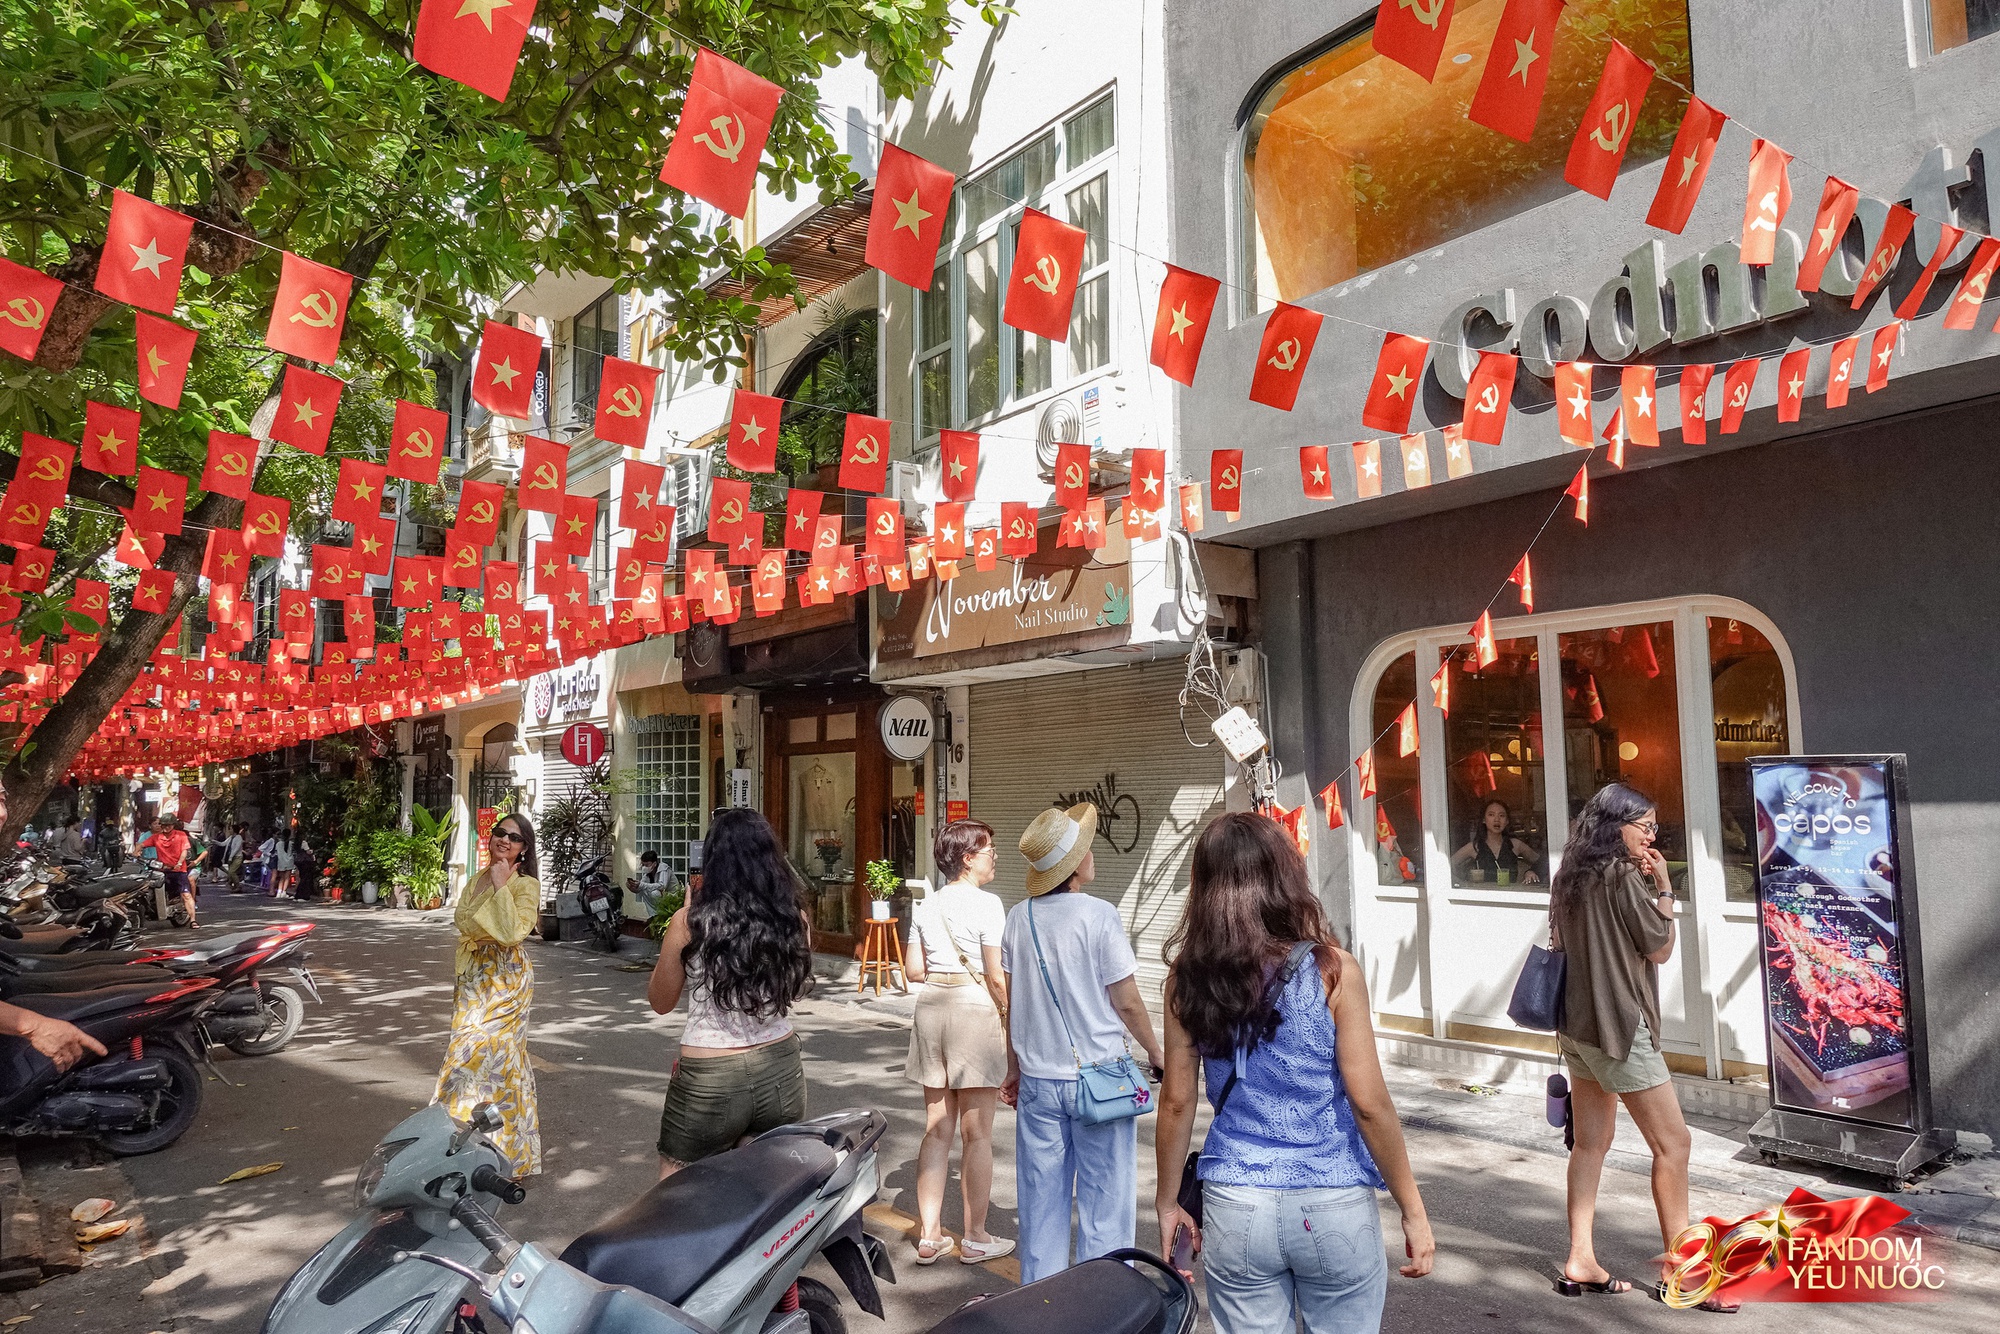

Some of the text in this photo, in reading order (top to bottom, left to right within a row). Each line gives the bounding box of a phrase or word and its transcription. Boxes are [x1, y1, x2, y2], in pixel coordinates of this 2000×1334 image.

[926, 557, 1057, 643] November
[1014, 602, 1088, 630] Nail Studio
[556, 670, 599, 697] La Flora
[888, 717, 930, 738] NAIL
[948, 743, 964, 764] 16
[1841, 792, 1857, 809] TO
[1774, 813, 1872, 841] capos
[1803, 892, 1834, 901] through
[1838, 895, 1881, 903] Godmother
[762, 1209, 815, 1259] VISION
